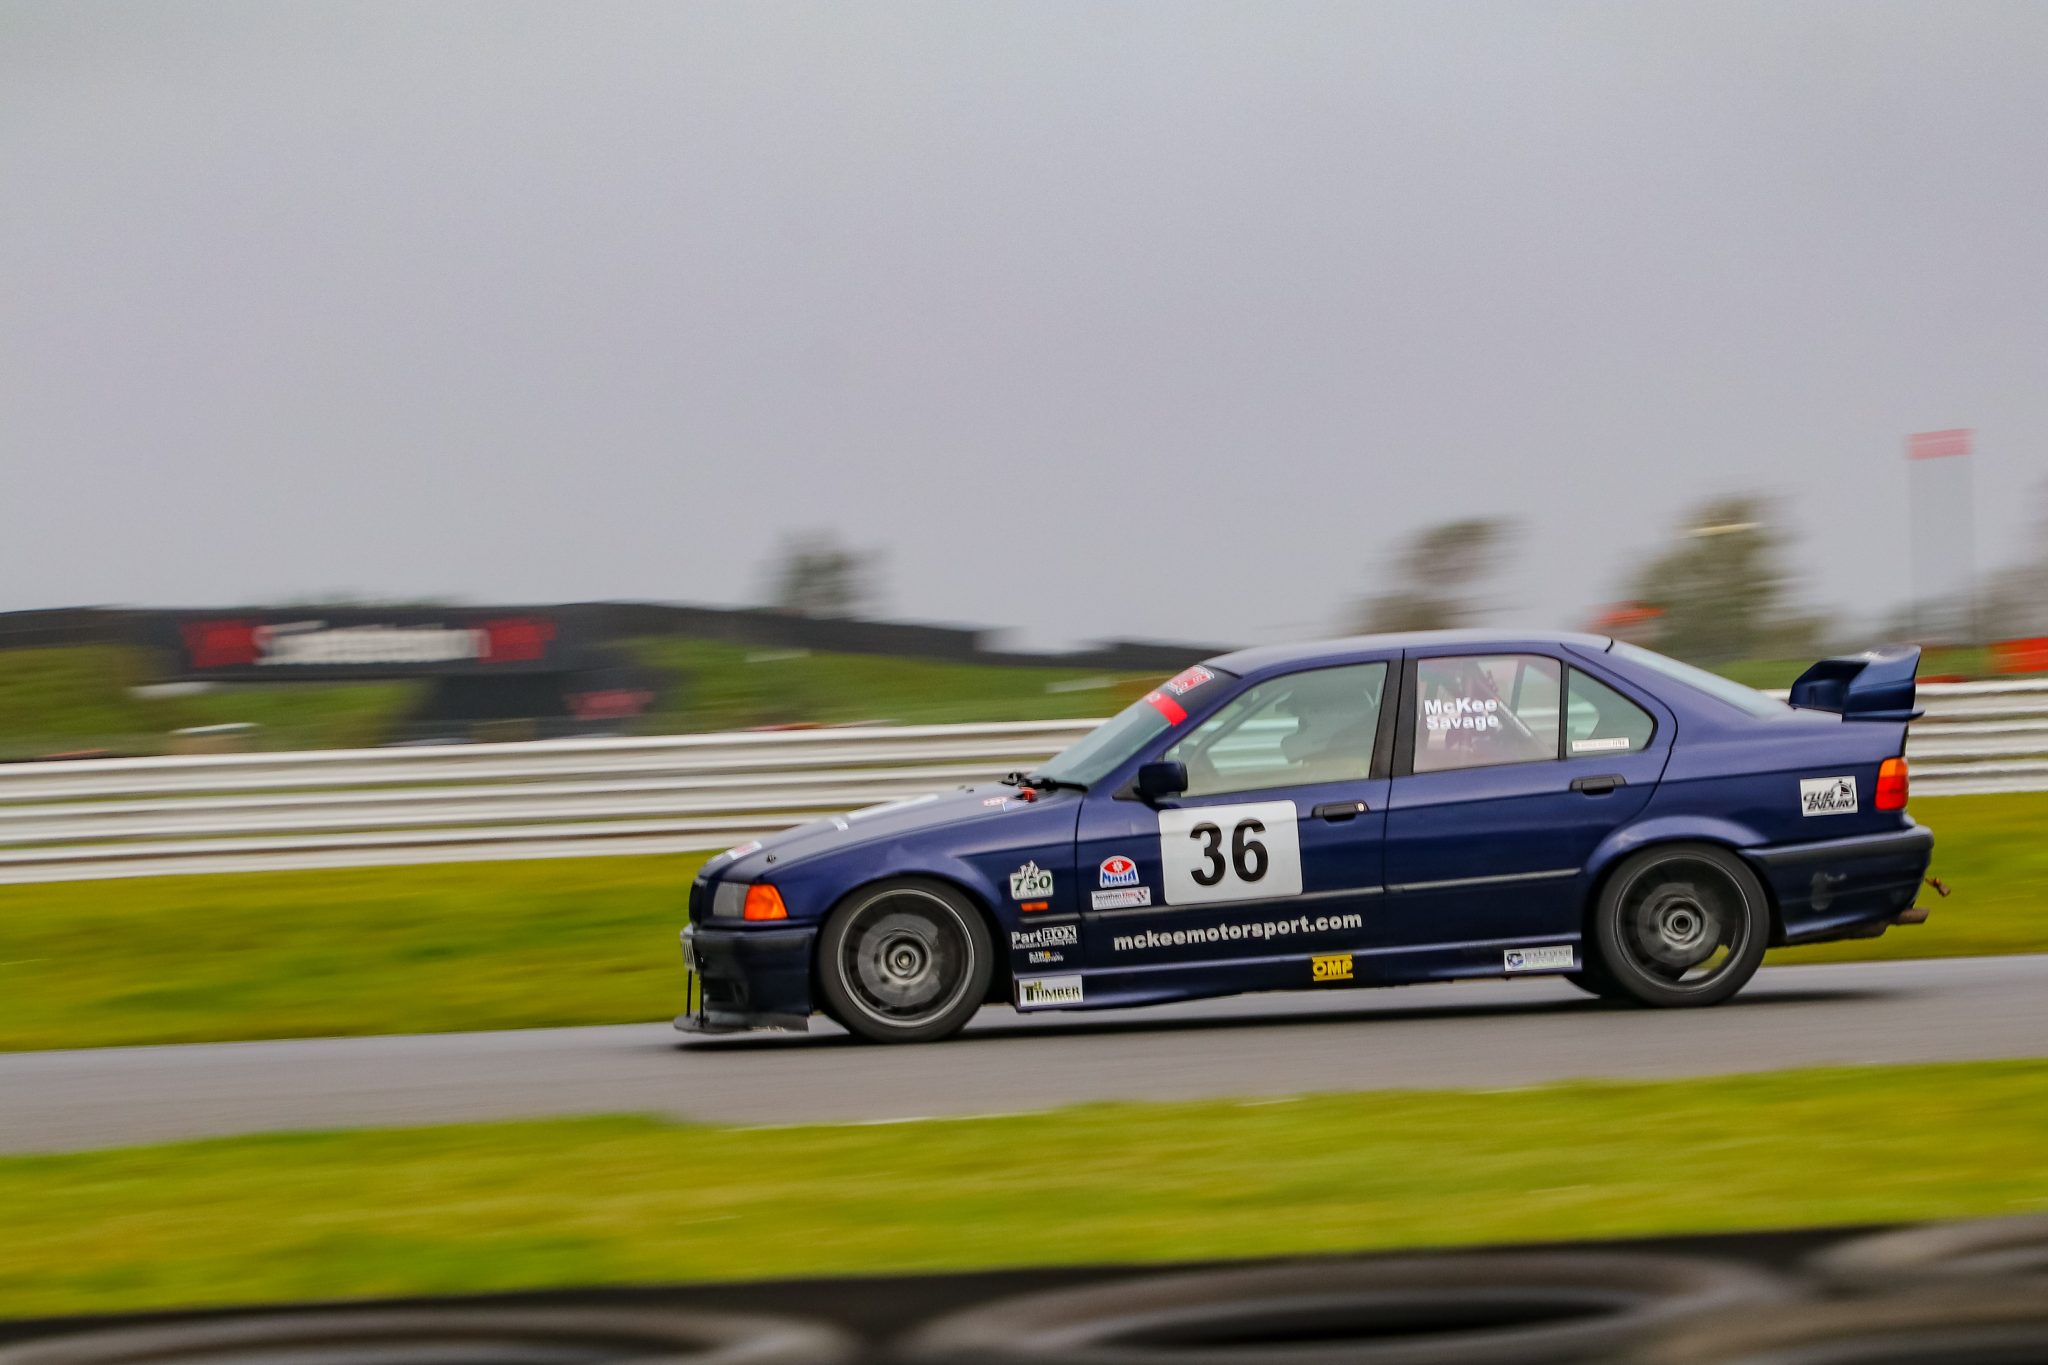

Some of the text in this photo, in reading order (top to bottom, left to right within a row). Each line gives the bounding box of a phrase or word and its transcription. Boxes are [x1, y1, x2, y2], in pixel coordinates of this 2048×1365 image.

[1424, 697, 1498, 715] McKee
[1426, 715, 1499, 731] Savage
[1804, 791, 1834, 802] CLUB
[1808, 799, 1855, 810] ENDURO
[1190, 819, 1269, 887] 36
[1013, 876, 1051, 891] 750
[1113, 913, 1363, 951] mckeemotorsport.com
[1312, 960, 1353, 976] OMP
